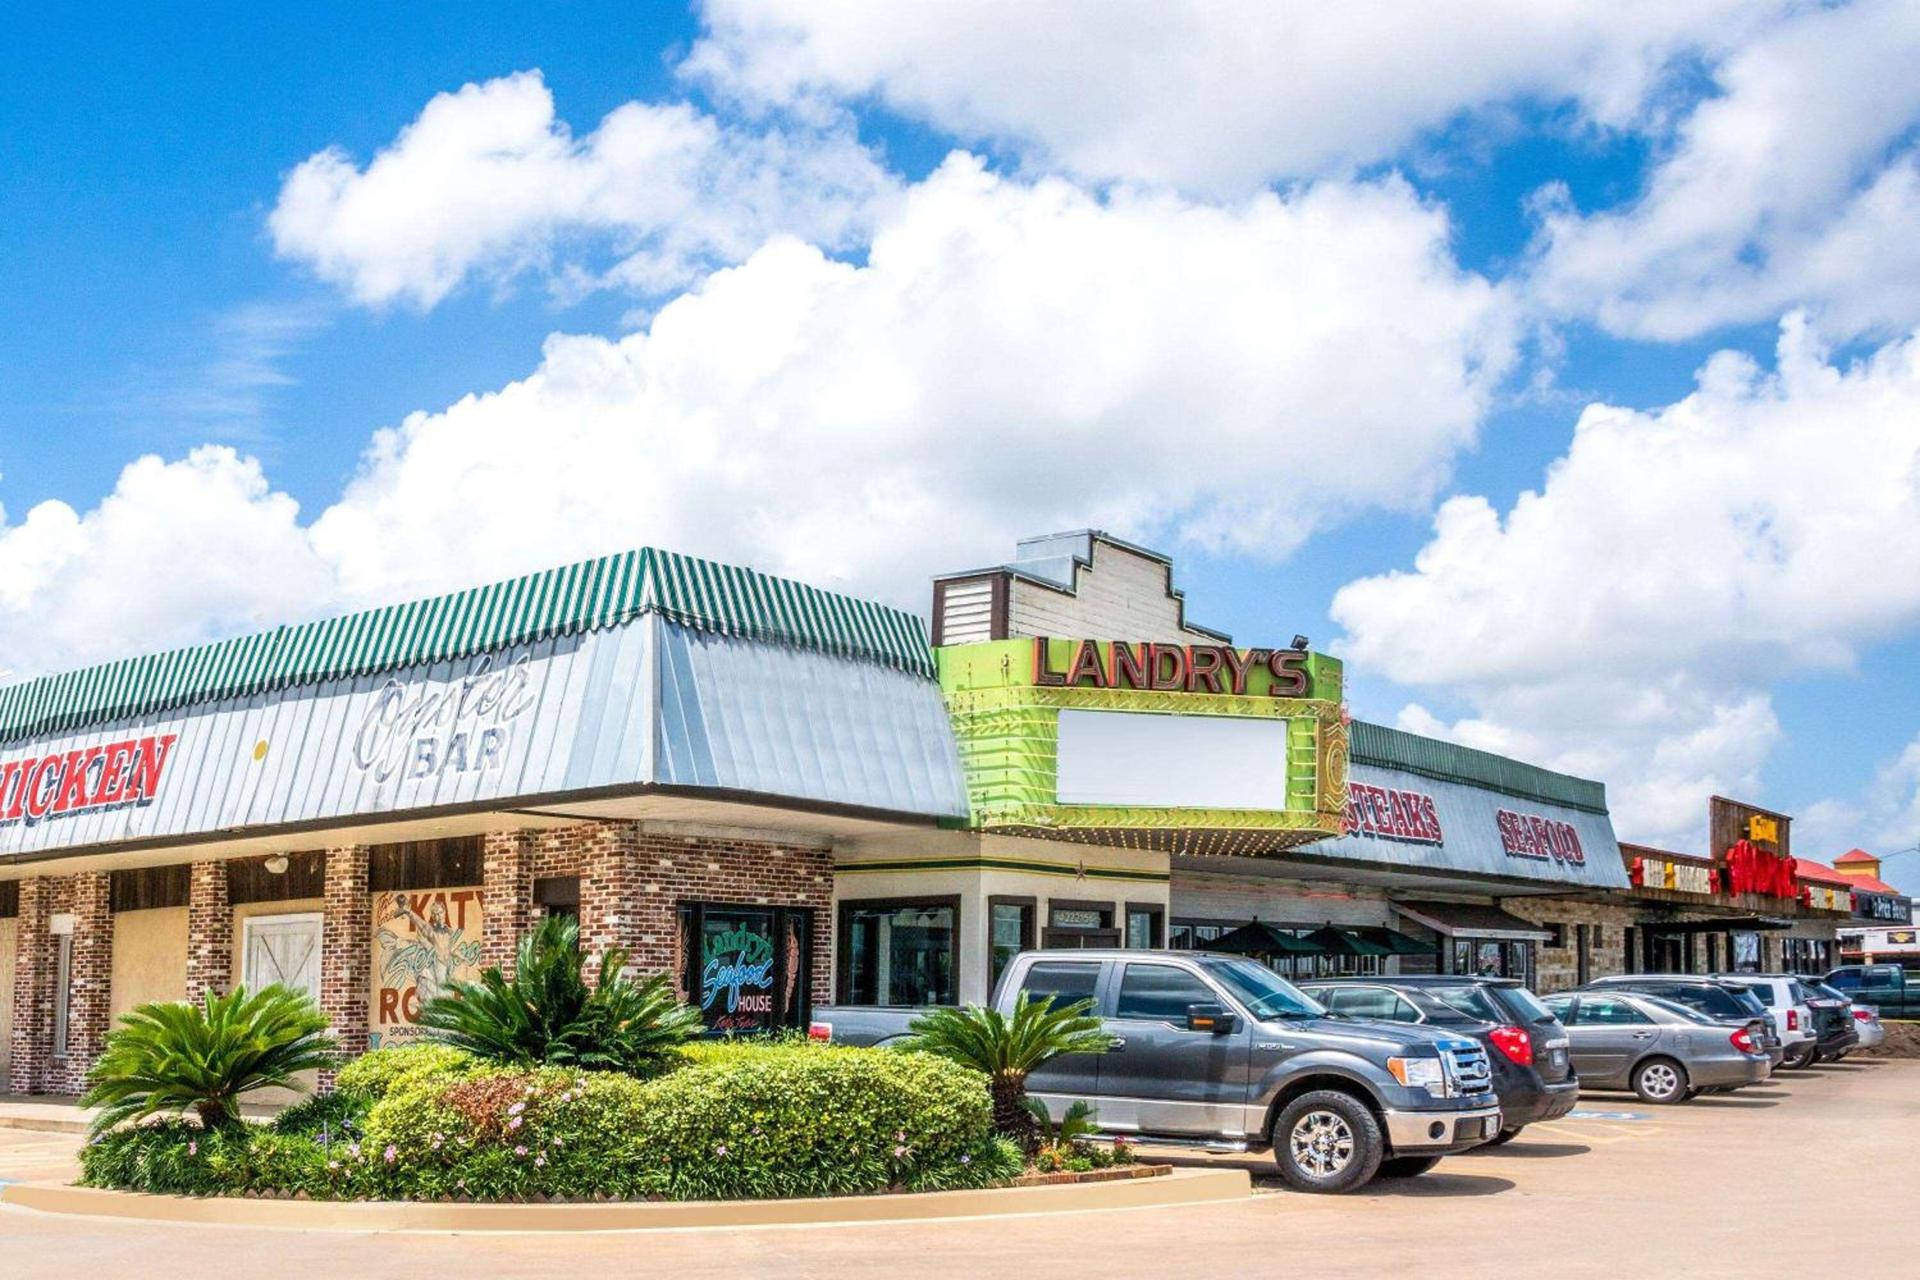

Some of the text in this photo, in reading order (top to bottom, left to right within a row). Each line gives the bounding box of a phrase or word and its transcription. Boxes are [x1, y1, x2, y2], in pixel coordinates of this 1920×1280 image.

[1032, 636, 1309, 697] LANDRY'S
[353, 653, 536, 783] Oyster
[406, 726, 508, 781] BAR
[1343, 781, 1443, 844] STEAKS
[1497, 808, 1585, 864] SEAFOOD
[702, 950, 774, 1013] Seafood
[738, 994, 772, 1012] HOUSE
